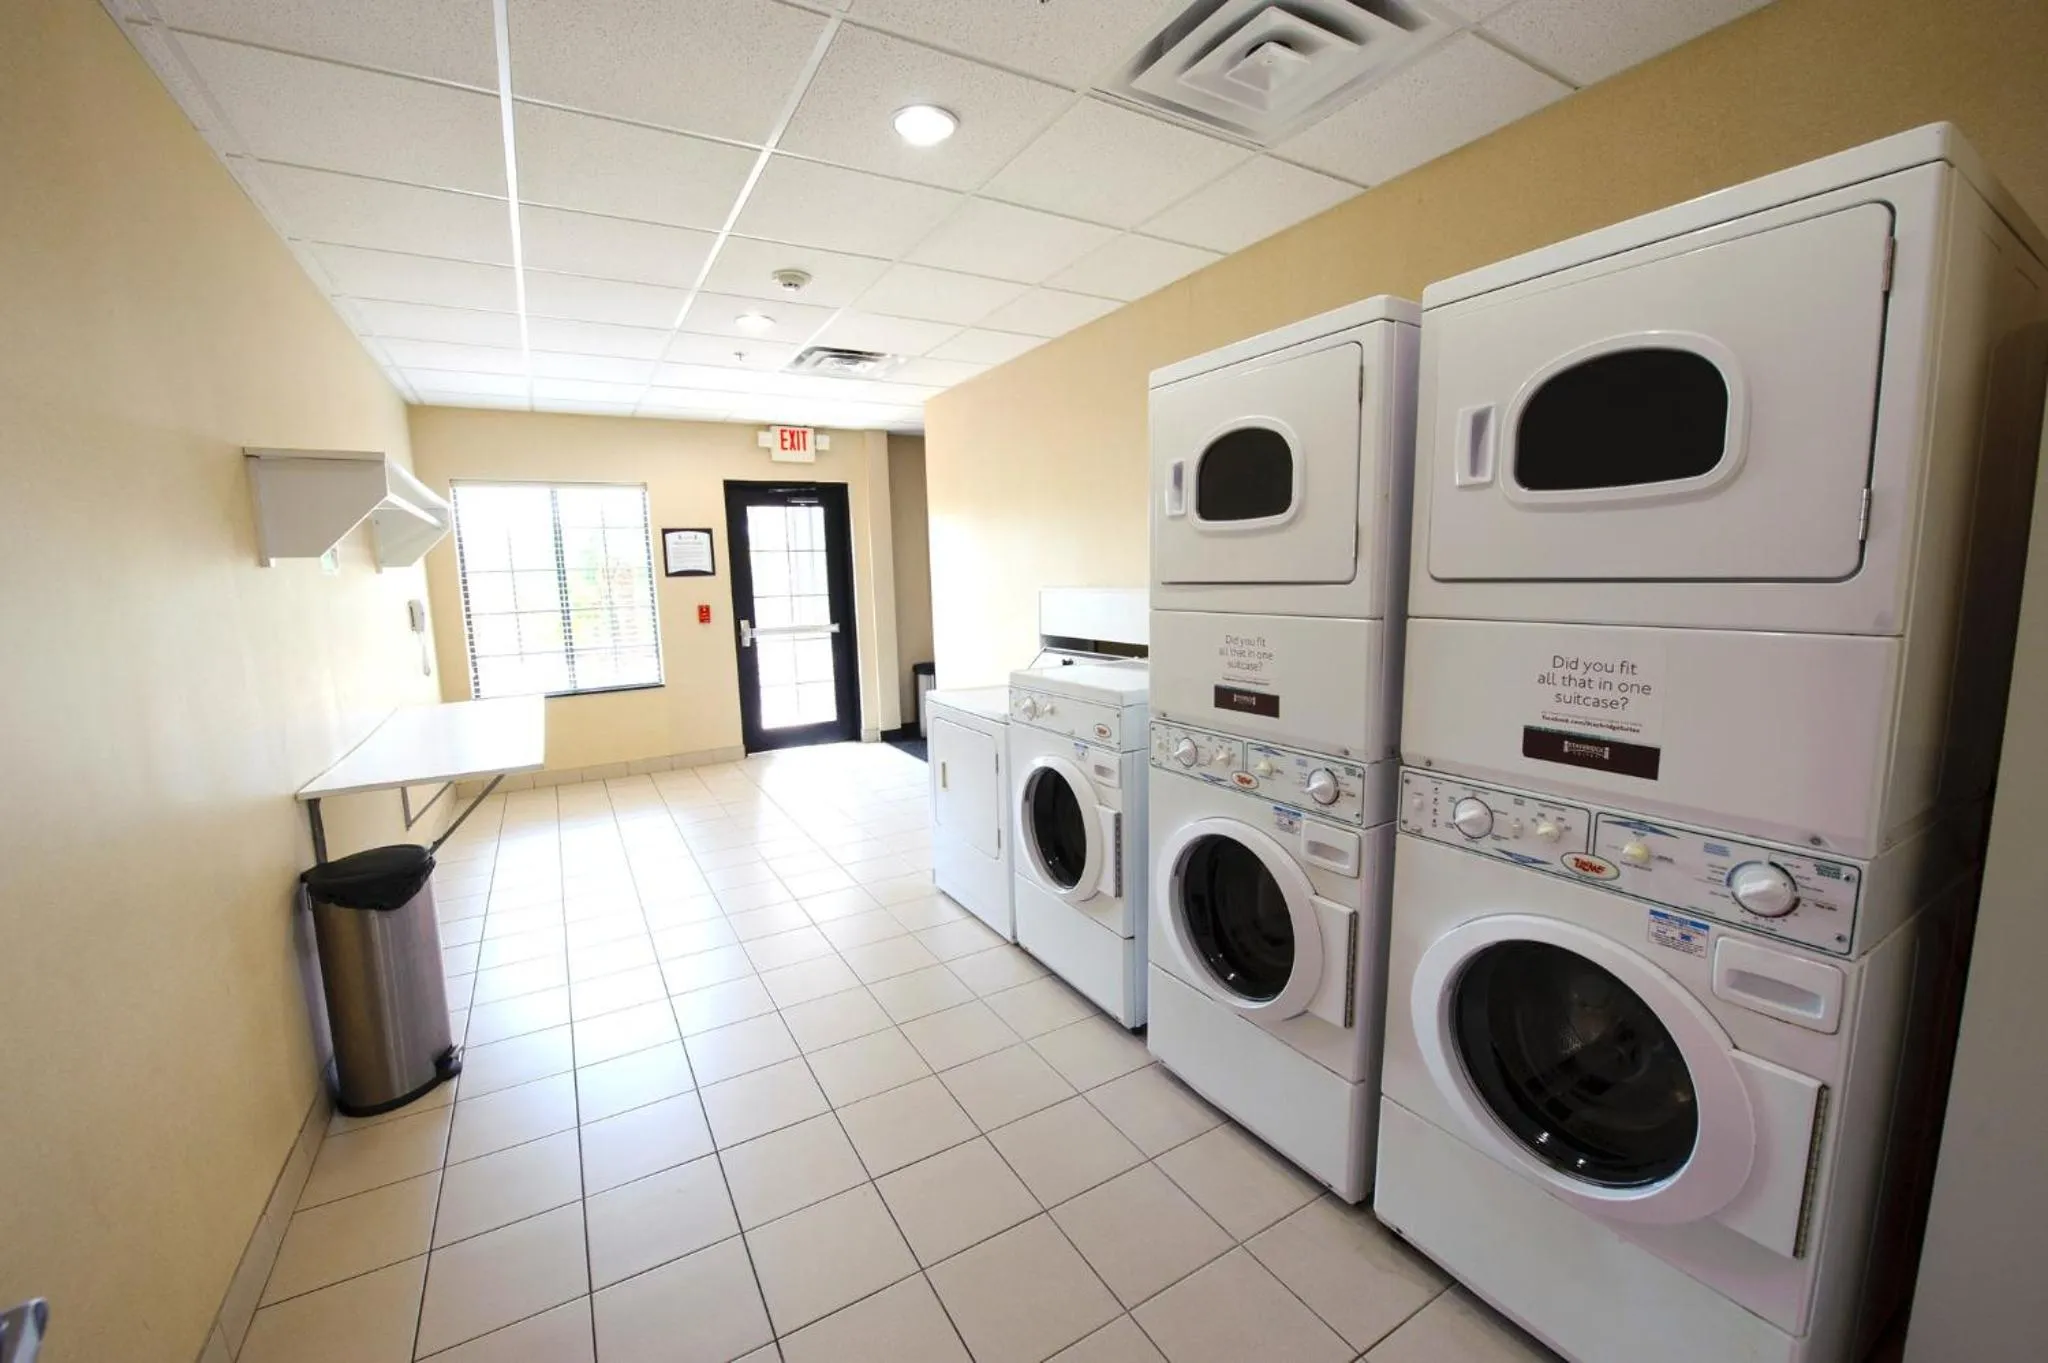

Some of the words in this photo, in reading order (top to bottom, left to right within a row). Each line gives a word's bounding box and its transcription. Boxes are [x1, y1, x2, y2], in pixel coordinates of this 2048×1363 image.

[779, 429, 807, 451] EXIT
[1552, 655, 1579, 671] Did
[1583, 660, 1615, 675] you
[1620, 660, 1638, 675] fit
[1537, 672, 1556, 686] all
[1562, 674, 1594, 690] that
[1598, 677, 1613, 691] in
[1618, 682, 1652, 695] one
[1554, 692, 1629, 711] suitcase?
